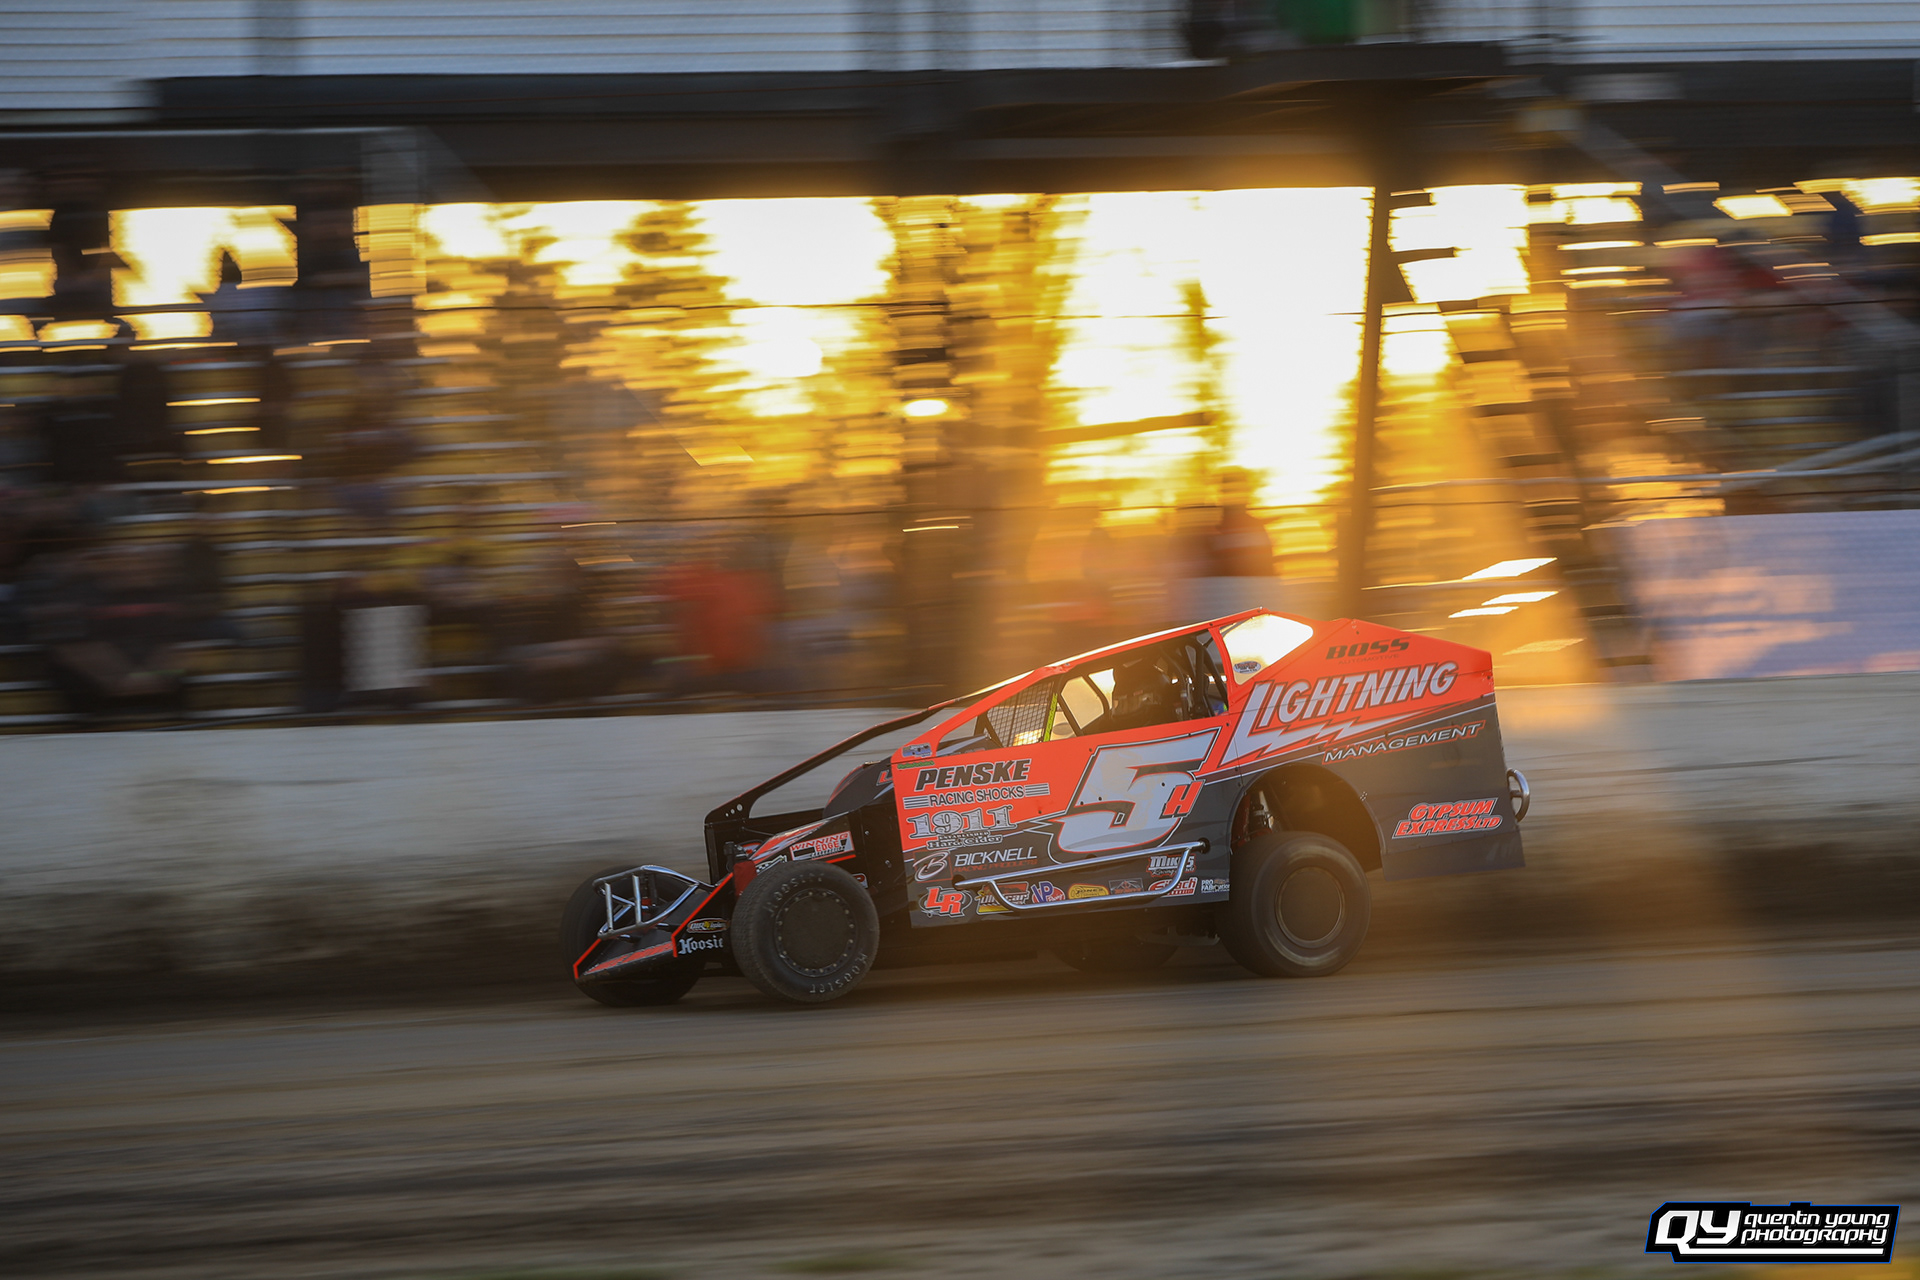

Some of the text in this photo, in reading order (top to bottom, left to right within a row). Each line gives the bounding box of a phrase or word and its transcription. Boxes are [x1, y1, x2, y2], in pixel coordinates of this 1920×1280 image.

[1326, 637, 1411, 660] BOSS
[1220, 661, 1459, 766] LIGHTNING
[1324, 722, 1484, 762] MANAGEMENT
[915, 759, 1032, 791] PENSKE
[929, 786, 1024, 807] RACING SHOCKS
[1410, 800, 1494, 820] GYPSUM
[907, 805, 1017, 838] 1911
[1395, 816, 1500, 836] EXPRESS LTD
[791, 833, 849, 851] WINNING
[815, 841, 840, 852] EDGE
[927, 835, 1003, 850] Hard Cider
[954, 846, 1038, 867] BICKNELL
